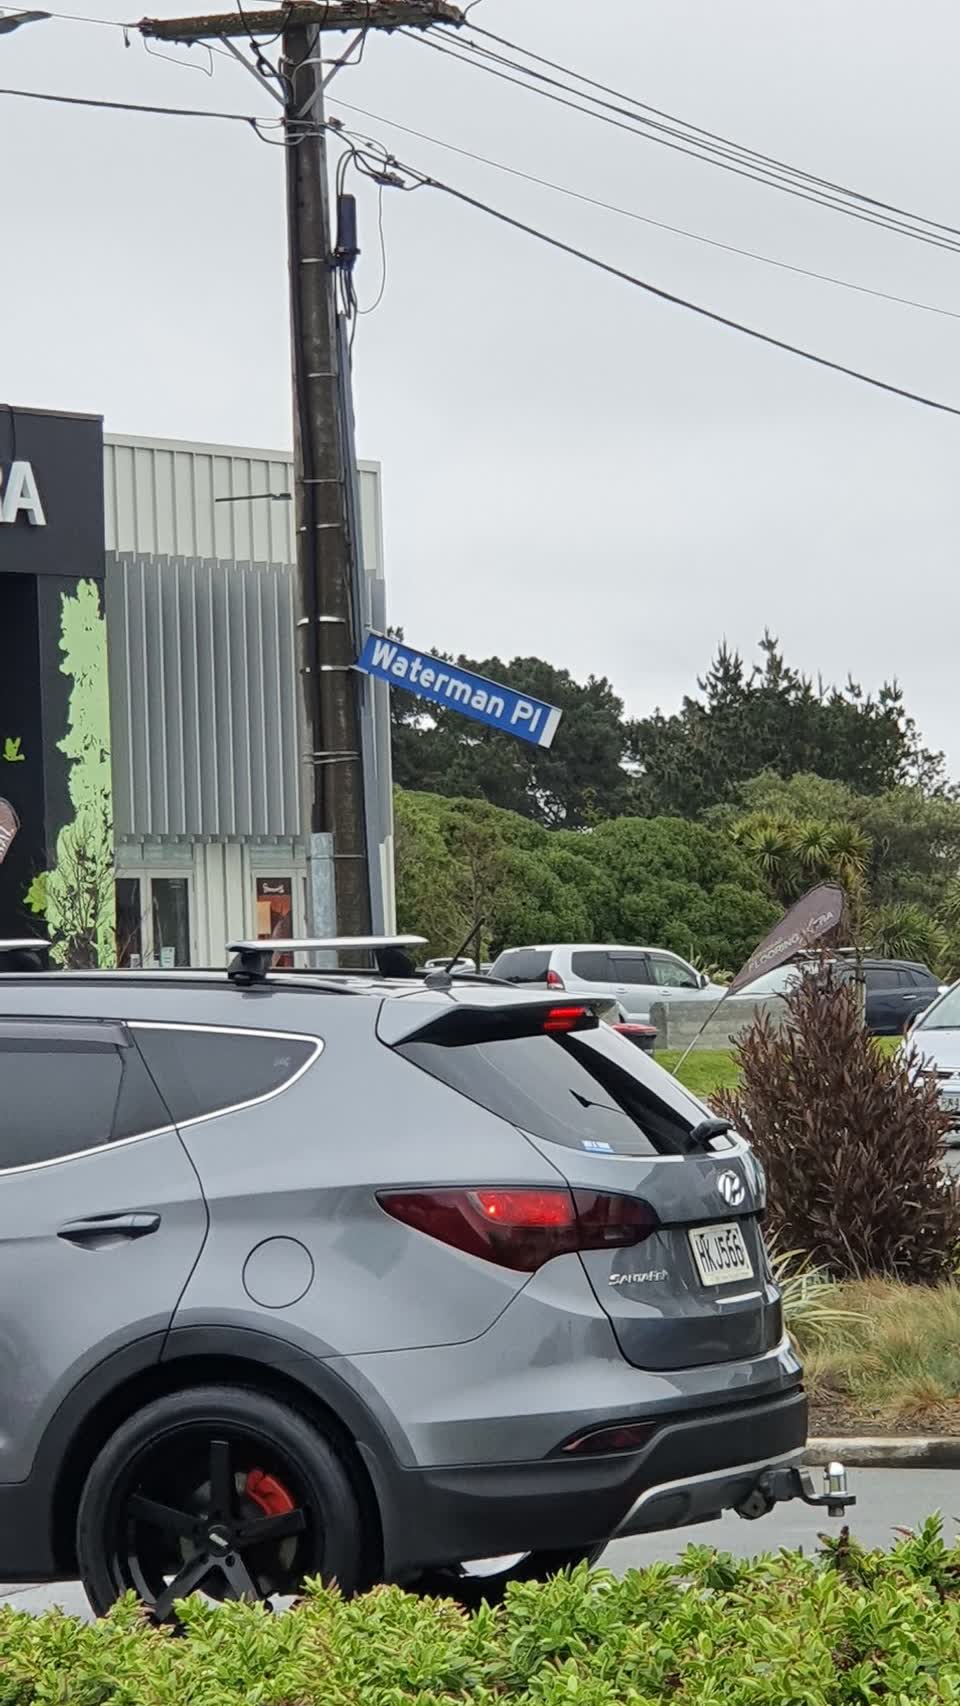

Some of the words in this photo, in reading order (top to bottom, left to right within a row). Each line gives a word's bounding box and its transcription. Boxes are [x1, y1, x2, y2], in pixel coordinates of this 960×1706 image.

[0, 461, 47, 526] A
[371, 640, 505, 718] Waterman
[510, 699, 542, 732] Pl
[695, 1233, 745, 1273] HKJ566
